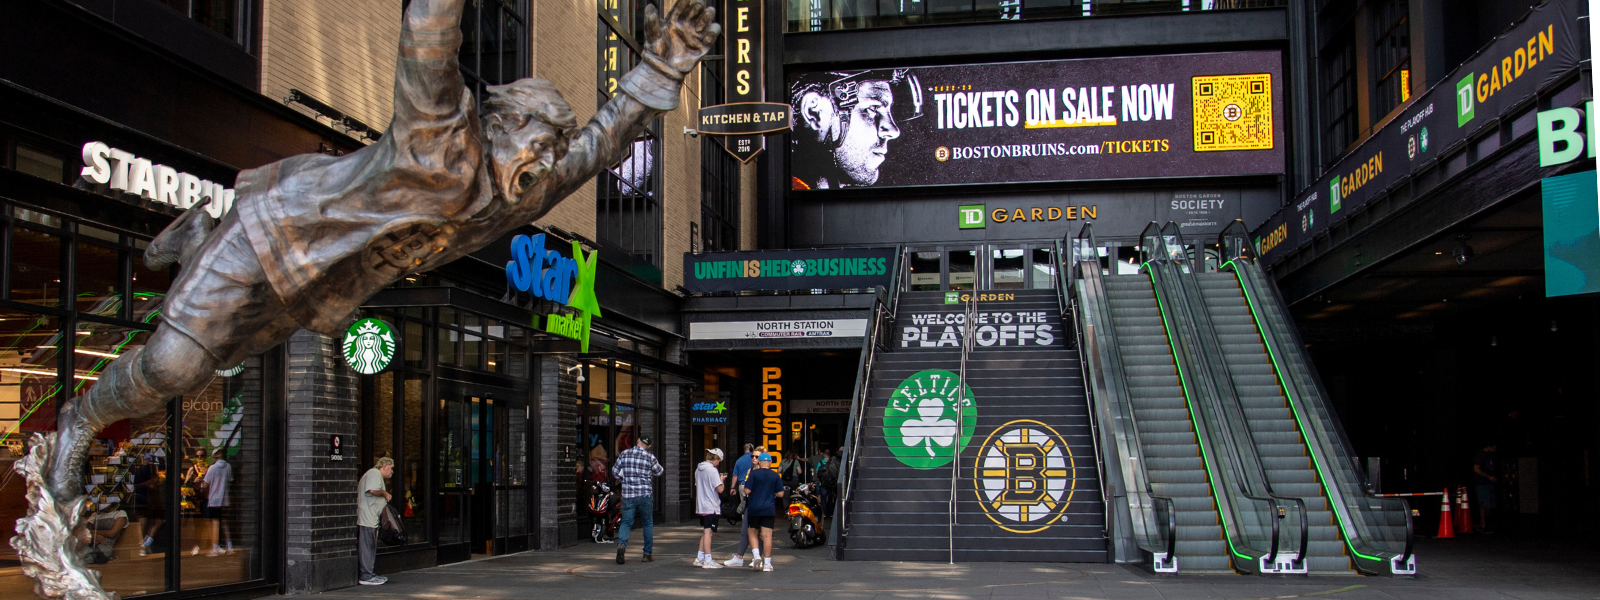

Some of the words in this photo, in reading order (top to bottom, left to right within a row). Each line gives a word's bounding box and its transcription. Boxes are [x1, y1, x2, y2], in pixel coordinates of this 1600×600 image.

[736, 0, 751, 95] ERS
[1458, 83, 1473, 117] TD
[1476, 23, 1554, 103] GARDEN
[934, 89, 1020, 129] TICKETS
[1025, 88, 1056, 126] ON
[1062, 86, 1116, 124] SALE
[1121, 83, 1175, 122] NOW
[1425, 103, 1434, 117] HUB
[702, 113, 751, 125] KITCHEN
[752, 112, 761, 123] &
[762, 111, 785, 122] TAP
[1341, 150, 1383, 199] GARDEN
[961, 208, 984, 225] TD
[991, 205, 1097, 223] GARDEN
[1171, 199, 1225, 210] SOCIETY
[1261, 221, 1288, 256] GARDEN
[694, 259, 791, 280] UNFINISHED
[807, 257, 887, 277] BUSINESS
[546, 313, 584, 340] market
[756, 321, 791, 331] NORTH
[793, 321, 834, 330] STATION
[991, 312, 1013, 324] TO
[1016, 311, 1047, 323] THE
